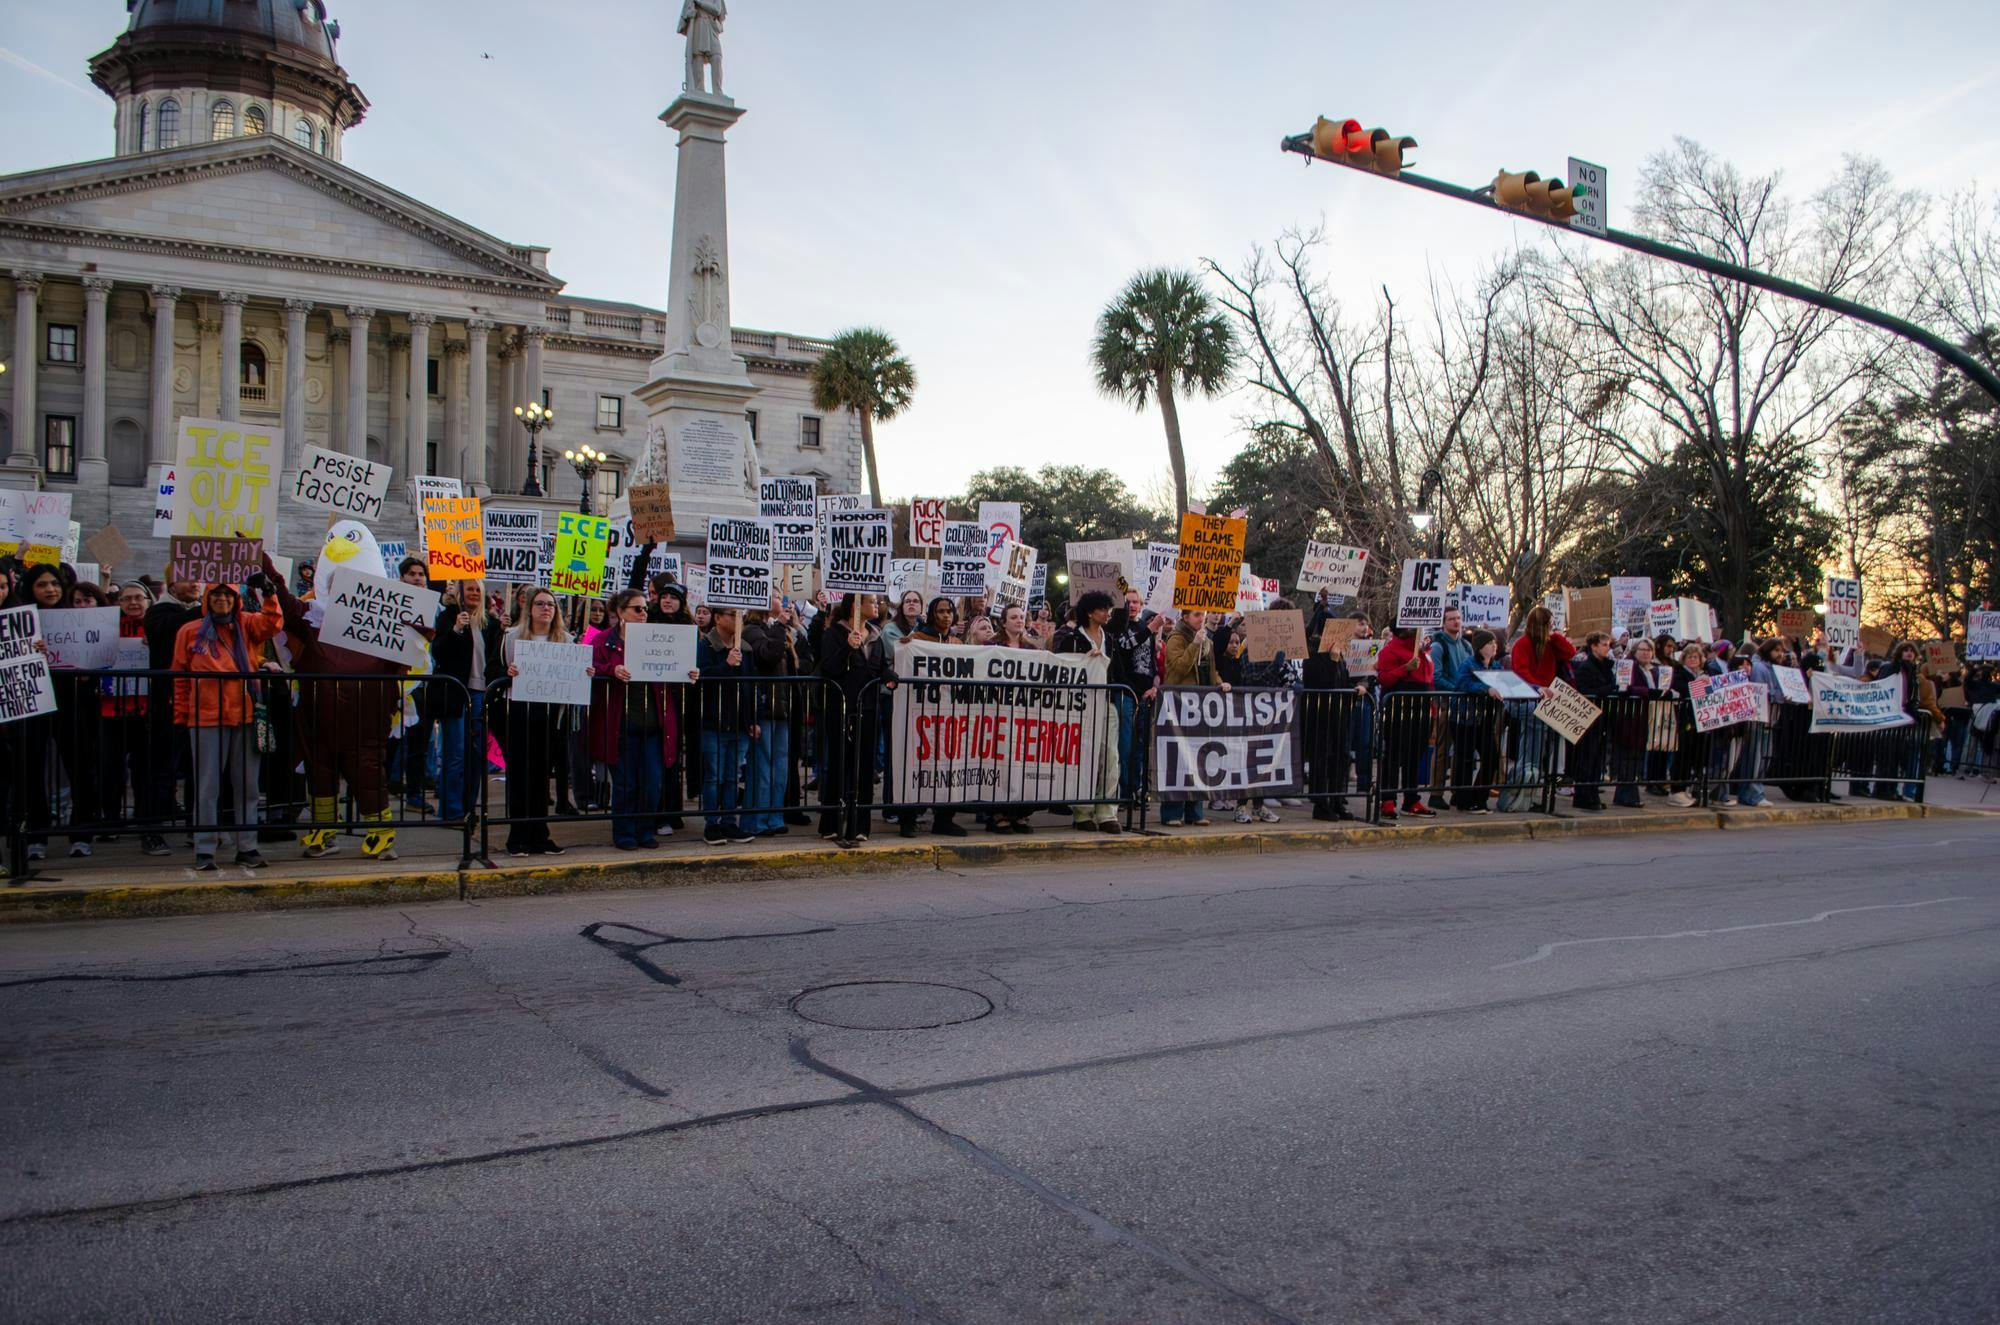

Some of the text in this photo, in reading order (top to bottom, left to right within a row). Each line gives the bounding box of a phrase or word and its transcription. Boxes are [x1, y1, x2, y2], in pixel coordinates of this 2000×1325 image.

[1579, 166, 1597, 183] NO
[1581, 199, 1595, 212] ON
[1579, 215, 1597, 228] RED
[186, 426, 270, 476] ICE
[313, 454, 375, 486] resist
[190, 471, 270, 514] OUT
[296, 469, 382, 518] fascism
[420, 479, 458, 490] HONOR
[760, 483, 813, 502] COLUMBIA
[425, 500, 476, 513] WAKE UP
[760, 503, 813, 517] MINNEAPOLIS
[187, 510, 265, 538] NOW
[428, 515, 480, 531] AND SMELL
[488, 512, 537, 529] WALKOUT!
[728, 519, 756, 527] FROM
[831, 512, 886, 522] HONOR
[1202, 517, 1227, 530] THEY
[559, 516, 608, 540] ICE
[711, 523, 770, 546] COLUMBIA
[772, 523, 814, 535] TOP
[831, 525, 865, 549] MLK
[867, 525, 887, 548] JR
[914, 519, 941, 545] ICE
[945, 527, 988, 544] COLUMBIA
[573, 539, 587, 556] IS
[778, 536, 813, 552] TERROR
[1194, 530, 1234, 547] BLAME
[175, 541, 263, 561] LOVE THY
[377, 543, 406, 557] UMAN
[485, 548, 514, 570] JAN
[515, 549, 536, 572] 20
[710, 543, 770, 562] MINNEAPOLIS
[943, 545, 987, 558] MINNEAPOLIS
[1180, 543, 1243, 564] IMMIGRANTS
[1307, 542, 1347, 561] Hands
[429, 550, 486, 573] FASCISM
[709, 563, 770, 578] STOP
[830, 549, 887, 574] SHUT IT
[942, 561, 986, 571] STOP
[1007, 544, 1031, 580] ICE
[1071, 560, 1120, 580] CHINGA
[1178, 560, 1191, 572] SO
[1194, 561, 1210, 575] YOU
[708, 576, 769, 597] ICE TERROR
[828, 571, 885, 584] DOWN!
[941, 572, 954, 586] ICE
[956, 574, 985, 586] TERROR
[1188, 573, 1226, 589] BLAME
[1412, 562, 1441, 592] ICE
[356, 582, 414, 608] MAKE
[1829, 577, 1858, 599] ICE
[1173, 588, 1238, 610] BILLIONAIRES
[1405, 596, 1418, 608] OUT
[1419, 597, 1427, 607] OF
[1427, 597, 1440, 608] OUR
[335, 593, 425, 626] AMERICA
[1400, 608, 1442, 618] COMMUNITIES
[351, 612, 405, 637] SANE
[1653, 619, 1677, 627] TRUMP
[46, 630, 100, 646] EGAL ON
[342, 626, 405, 651] AGAIN
[645, 629, 676, 643] Jesus
[1827, 626, 1858, 646] SOUTH
[21, 660, 46, 680] FOR
[912, 655, 1089, 685] FROM COLUMBIA
[912, 683, 1088, 712] TO MINNEAPOLIS
[1553, 679, 1596, 715] VETERANS
[1554, 694, 1589, 720] AGAINST
[1156, 690, 1296, 728] ABOLISH
[915, 714, 1082, 767] STOP ICE TERROR
[1165, 739, 1286, 788] I.C.E.
